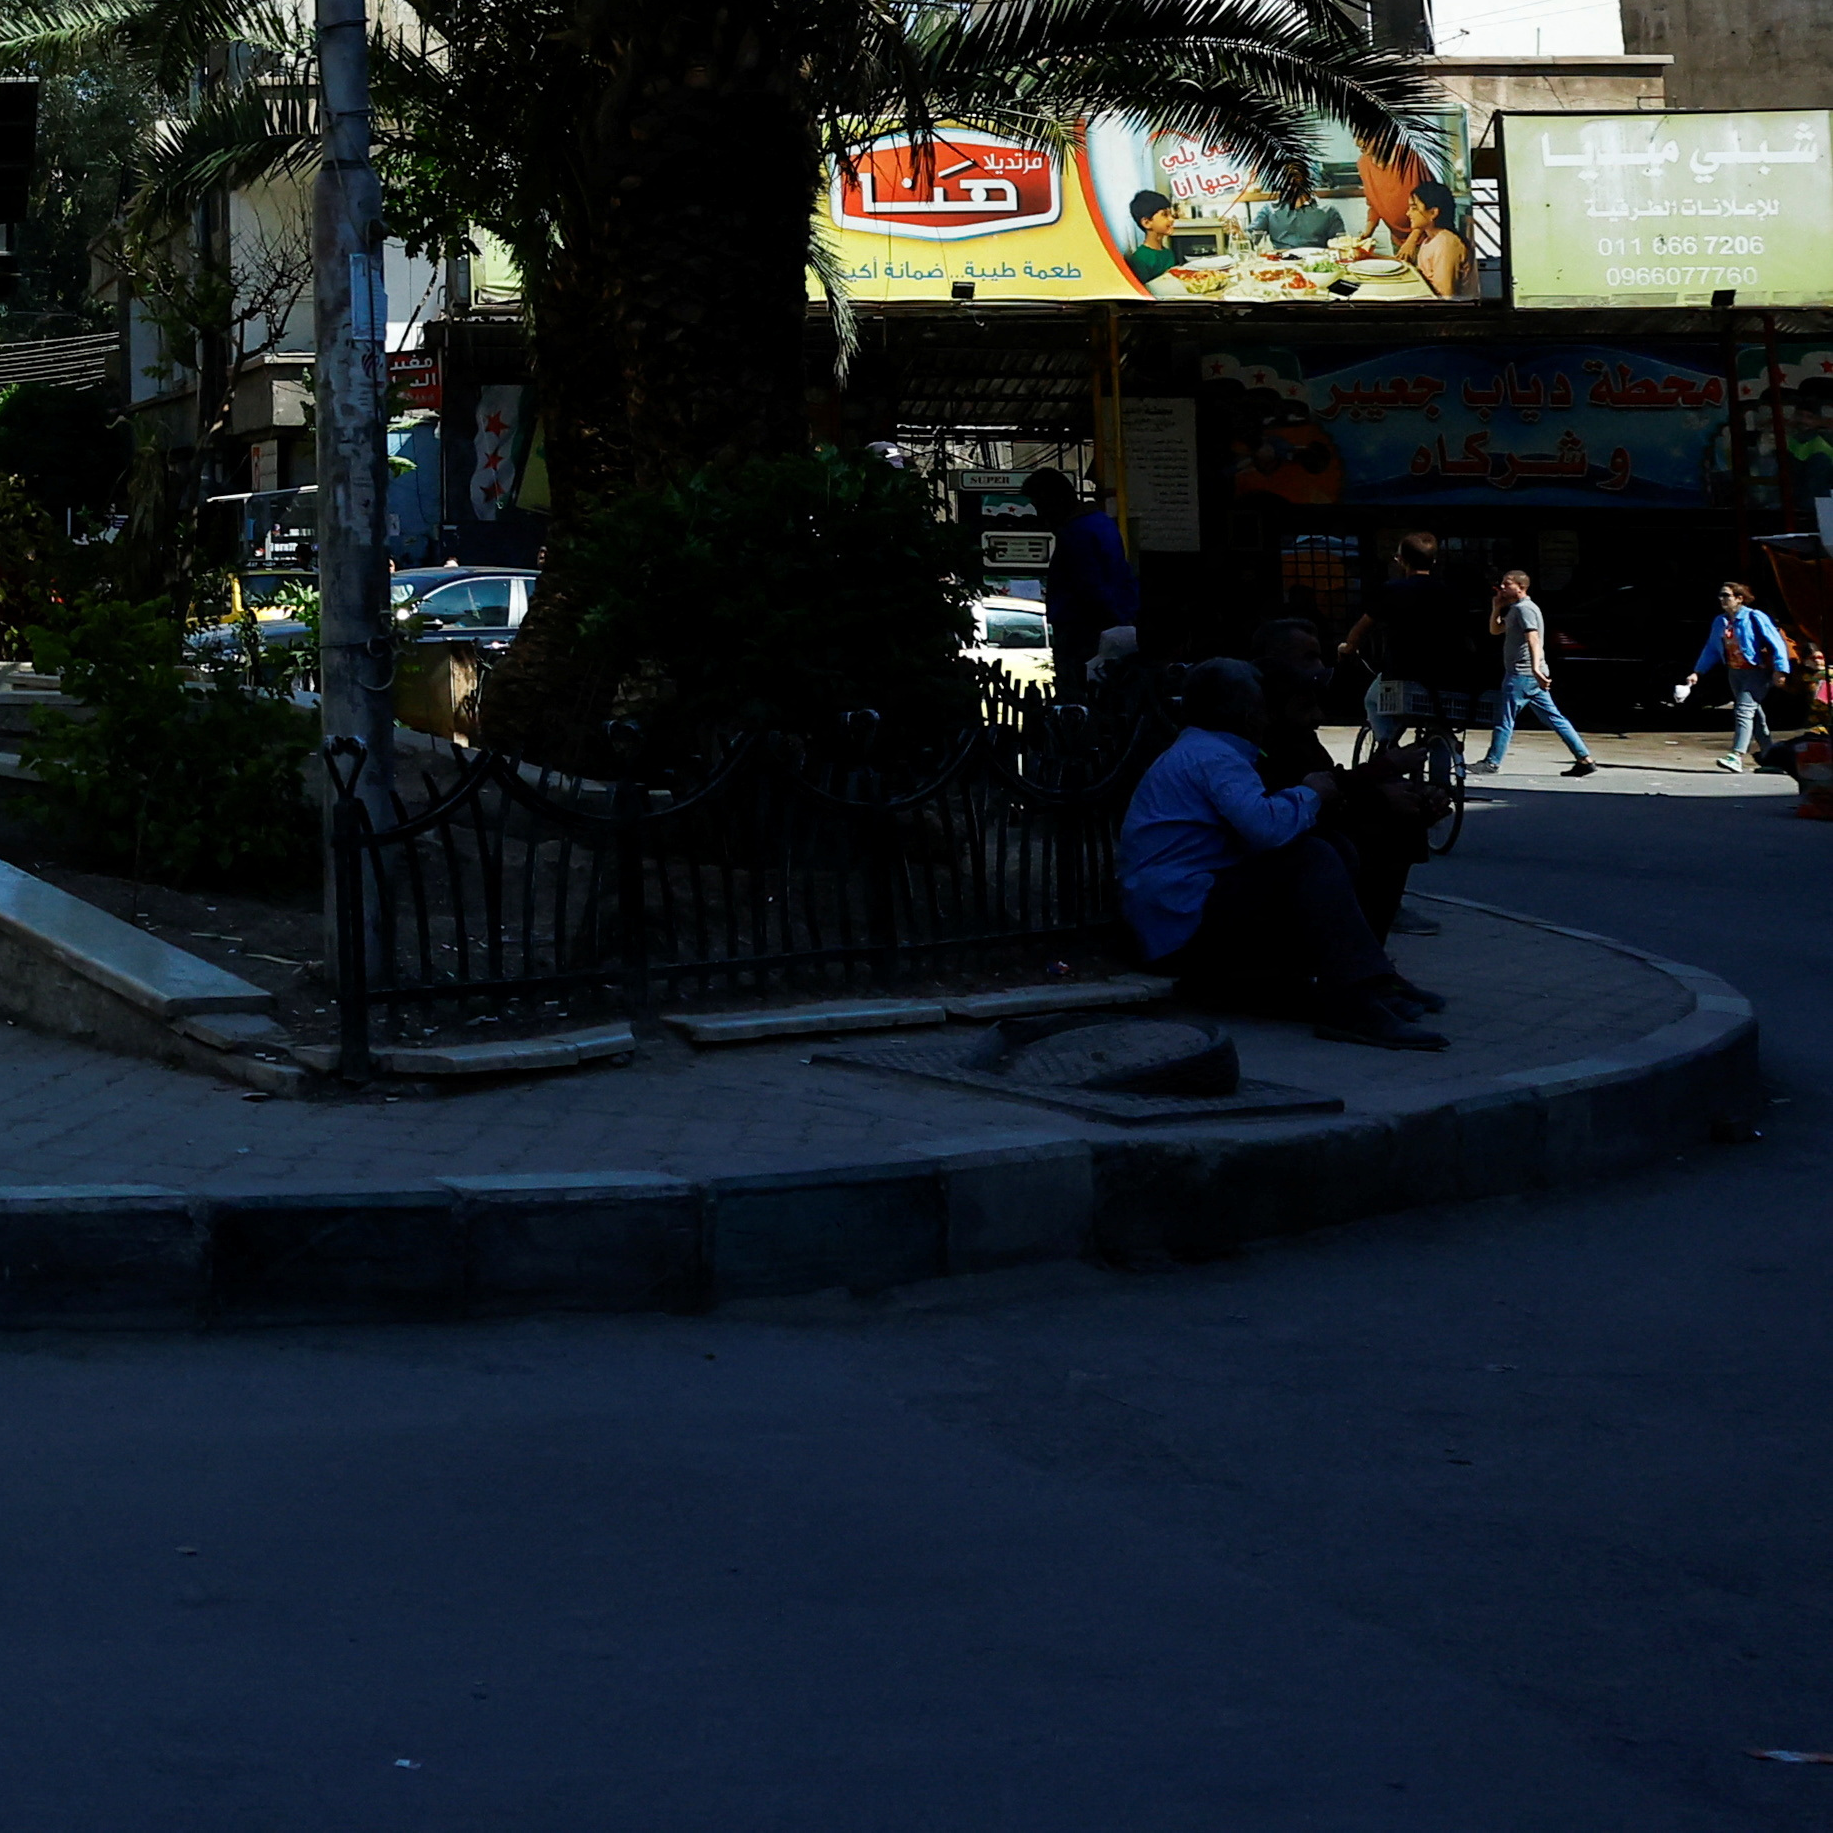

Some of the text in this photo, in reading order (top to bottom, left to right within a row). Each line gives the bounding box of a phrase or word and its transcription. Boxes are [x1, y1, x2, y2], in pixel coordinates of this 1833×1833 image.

[1688, 121, 1819, 184] شبلي
[982, 151, 1044, 177] مرتديلا
[1598, 236, 1764, 257] 011 666 7206
[884, 260, 945, 281] ضمانة
[1022, 261, 1083, 281] طعمة
[1605, 266, 1759, 287] 0966077760
[1315, 357, 1725, 424] محطة دياب جعيبر
[1407, 429, 1588, 490] شركاه
[969, 476, 1010, 484] SUPER
